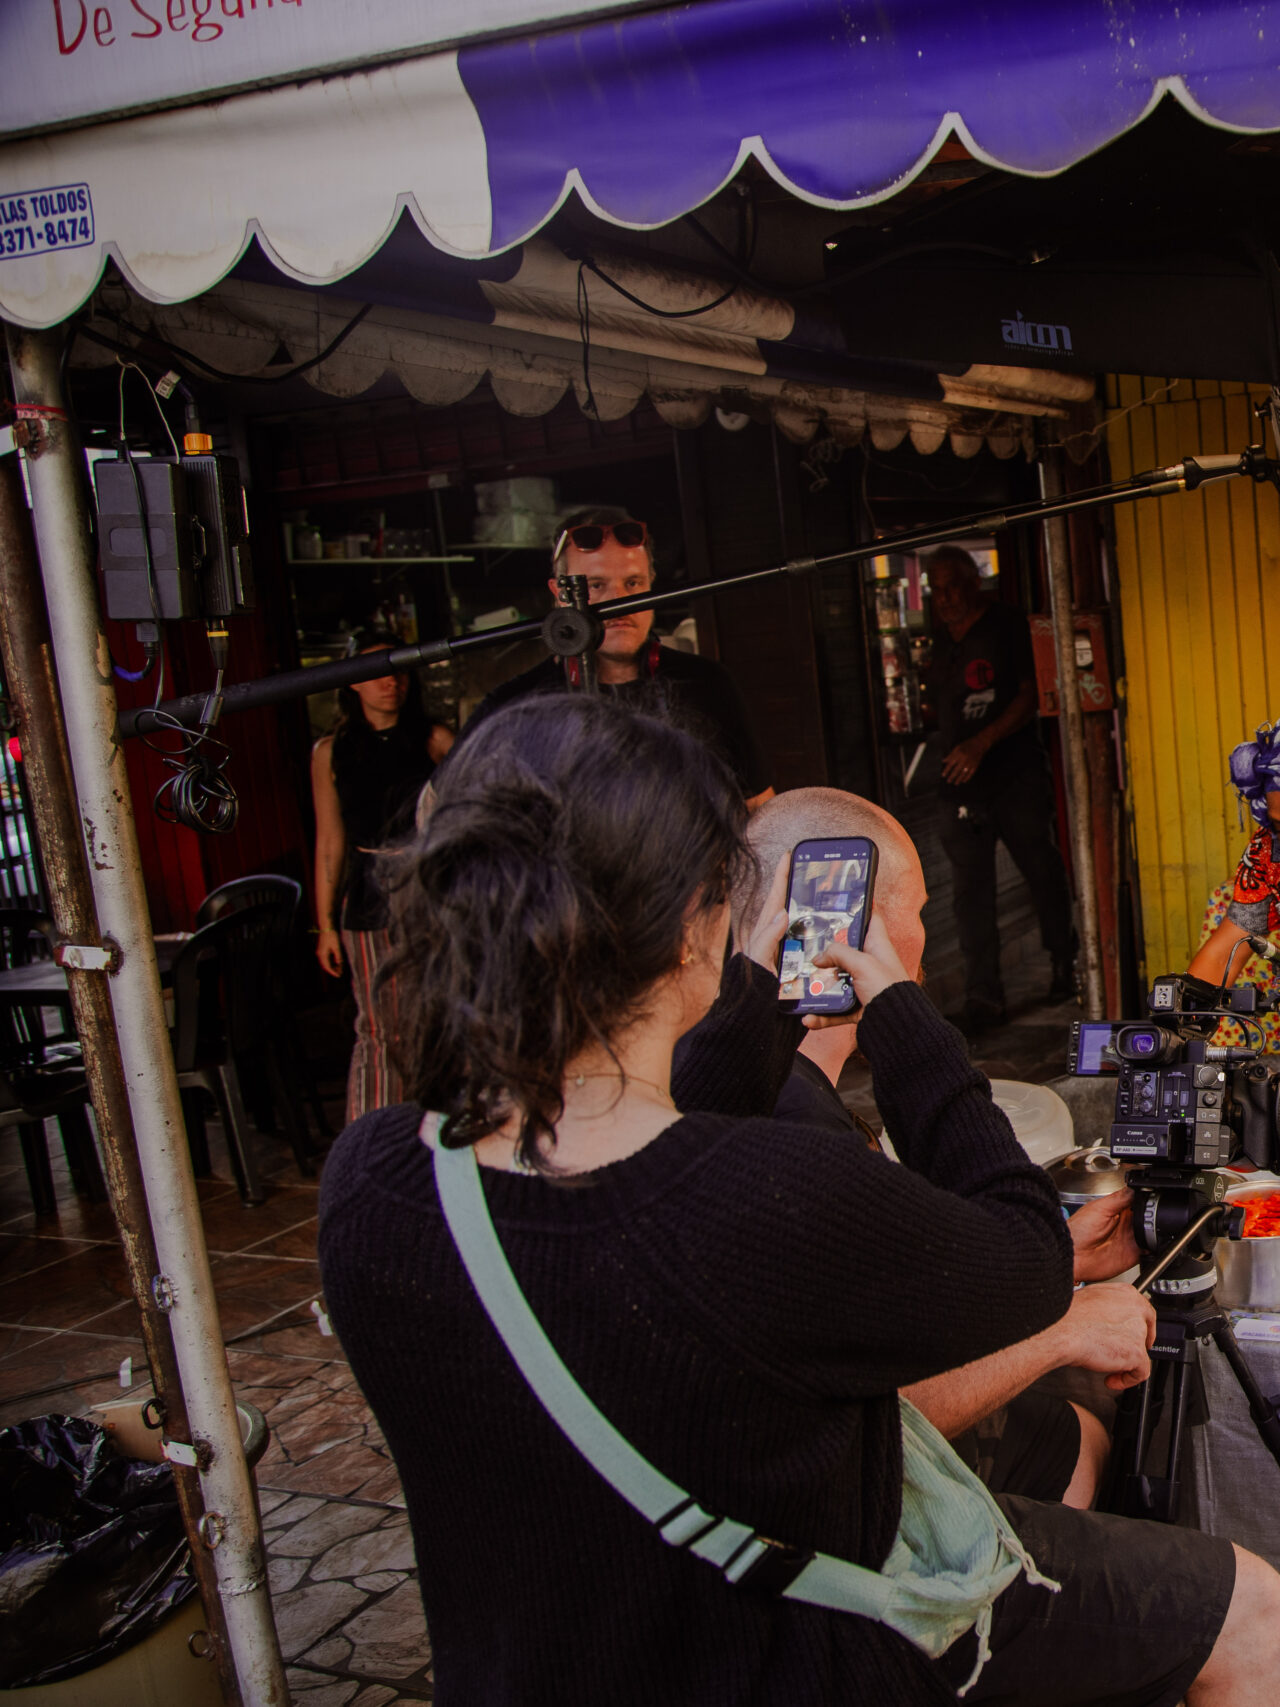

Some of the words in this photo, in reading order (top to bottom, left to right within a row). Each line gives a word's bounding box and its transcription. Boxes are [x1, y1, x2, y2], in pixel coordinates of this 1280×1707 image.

[54, 0, 116, 54] De
[0, 198, 28, 226] LAS
[30, 188, 88, 219] TOLDOS
